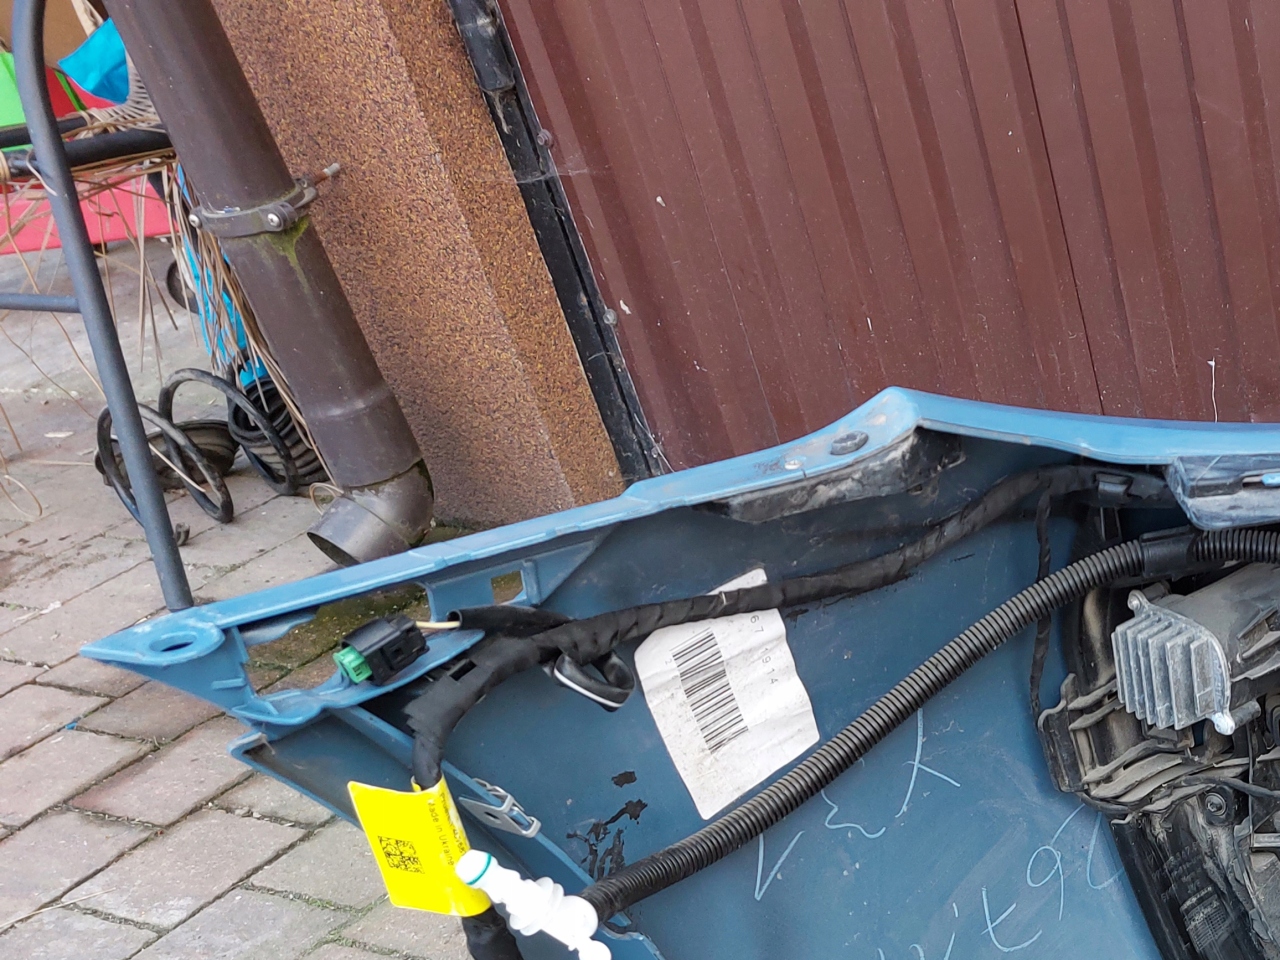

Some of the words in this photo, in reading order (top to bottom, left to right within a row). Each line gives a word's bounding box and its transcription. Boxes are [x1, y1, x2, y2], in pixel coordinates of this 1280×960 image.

[760, 647, 779, 685] 1914
[427, 799, 440, 823] Made
[435, 825, 443, 833] in
[438, 833, 455, 866] Ukraine
